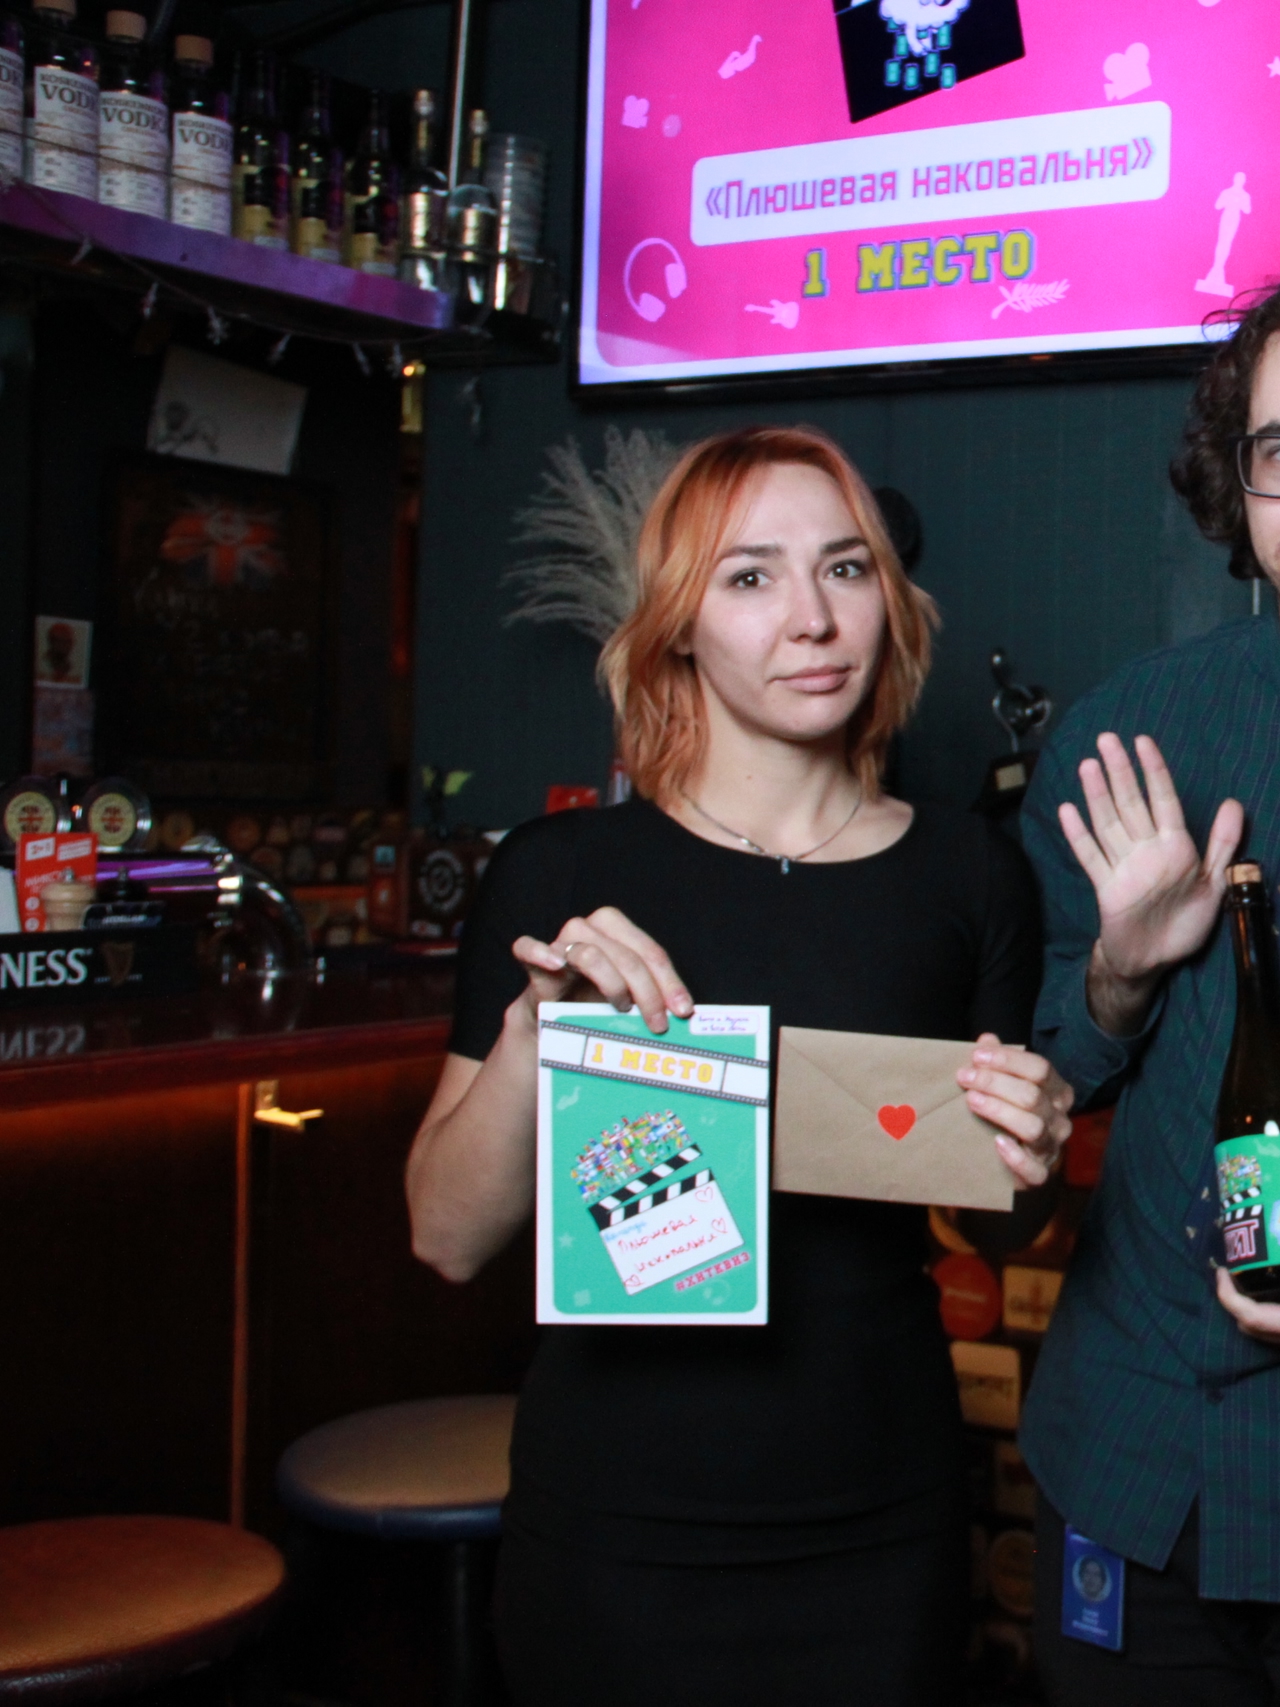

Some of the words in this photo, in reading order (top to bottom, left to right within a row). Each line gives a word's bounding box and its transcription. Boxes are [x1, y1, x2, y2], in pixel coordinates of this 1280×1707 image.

[705, 170, 897, 219] «Плюшевая
[912, 137, 1153, 198] наковальня»
[802, 248, 829, 298] 1
[856, 228, 1035, 293] МЕСТО
[0, 947, 89, 989] NESS
[591, 1043, 604, 1063] 1
[620, 1047, 714, 1083] МЕСТО
